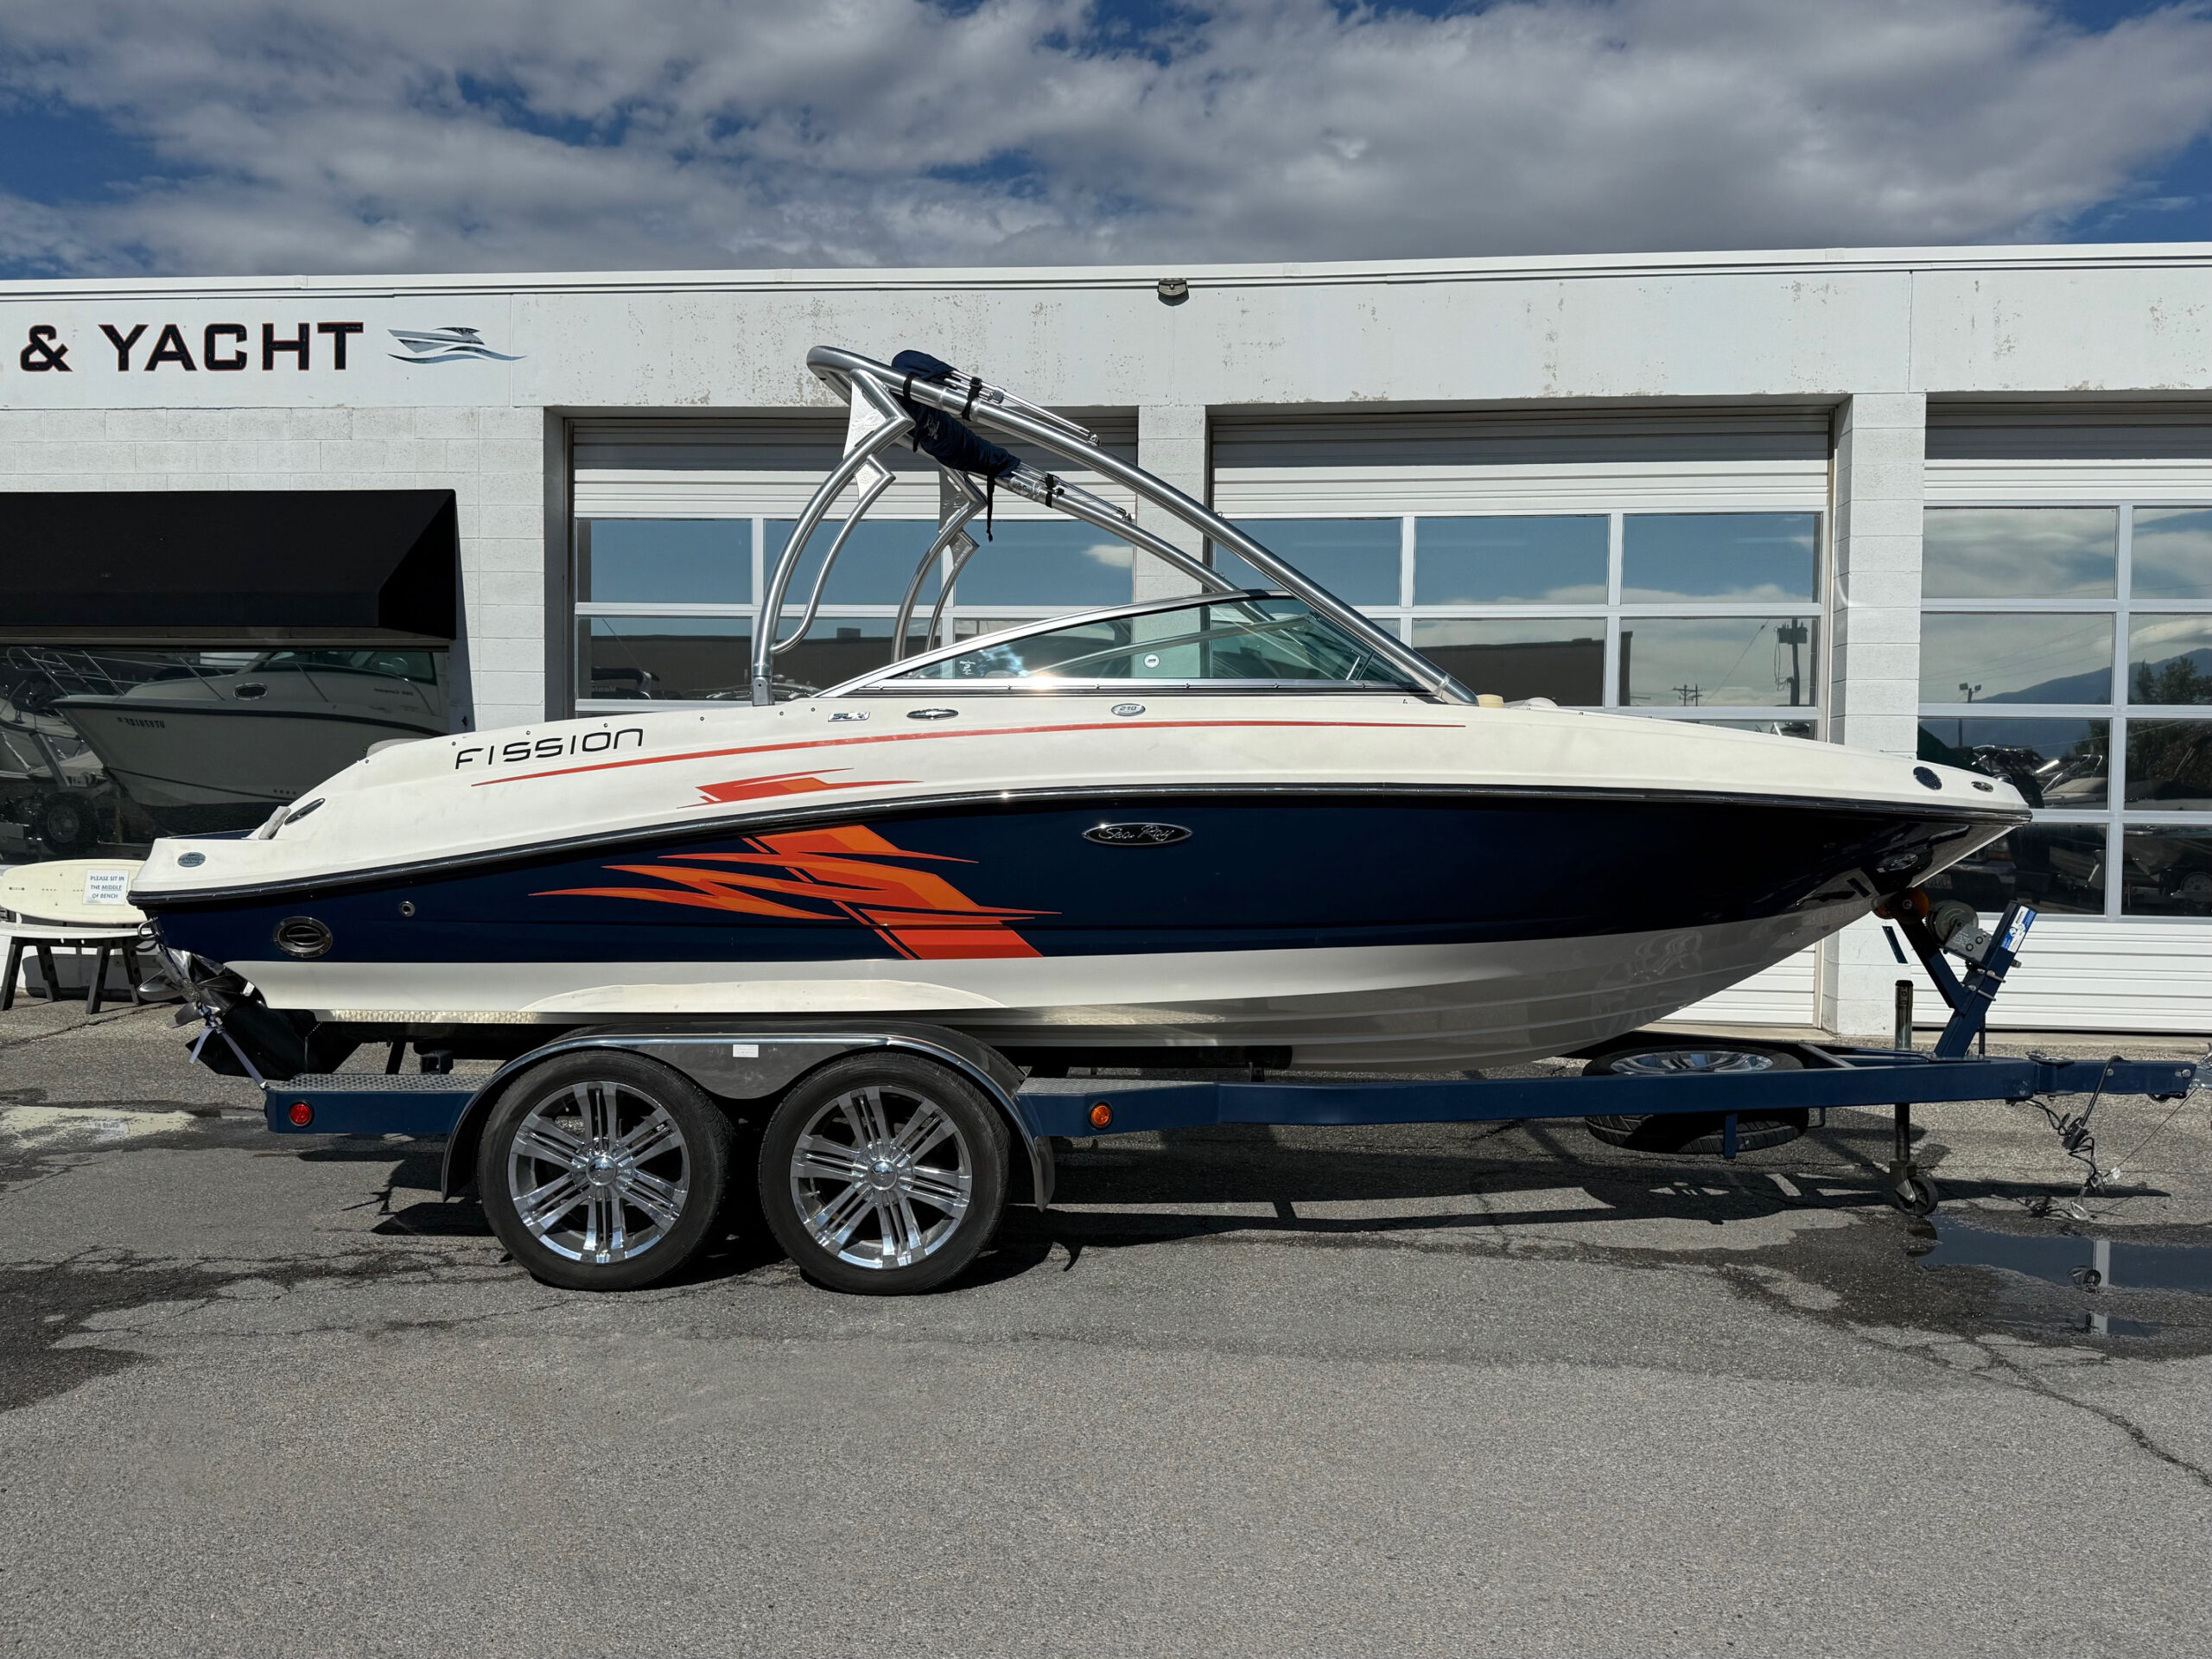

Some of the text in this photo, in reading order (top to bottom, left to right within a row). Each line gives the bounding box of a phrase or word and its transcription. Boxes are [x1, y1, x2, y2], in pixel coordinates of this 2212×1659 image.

[20, 321, 364, 372] & YACHT
[455, 728, 644, 770] FISSION
[1098, 824, 1174, 842] Sea Ray
